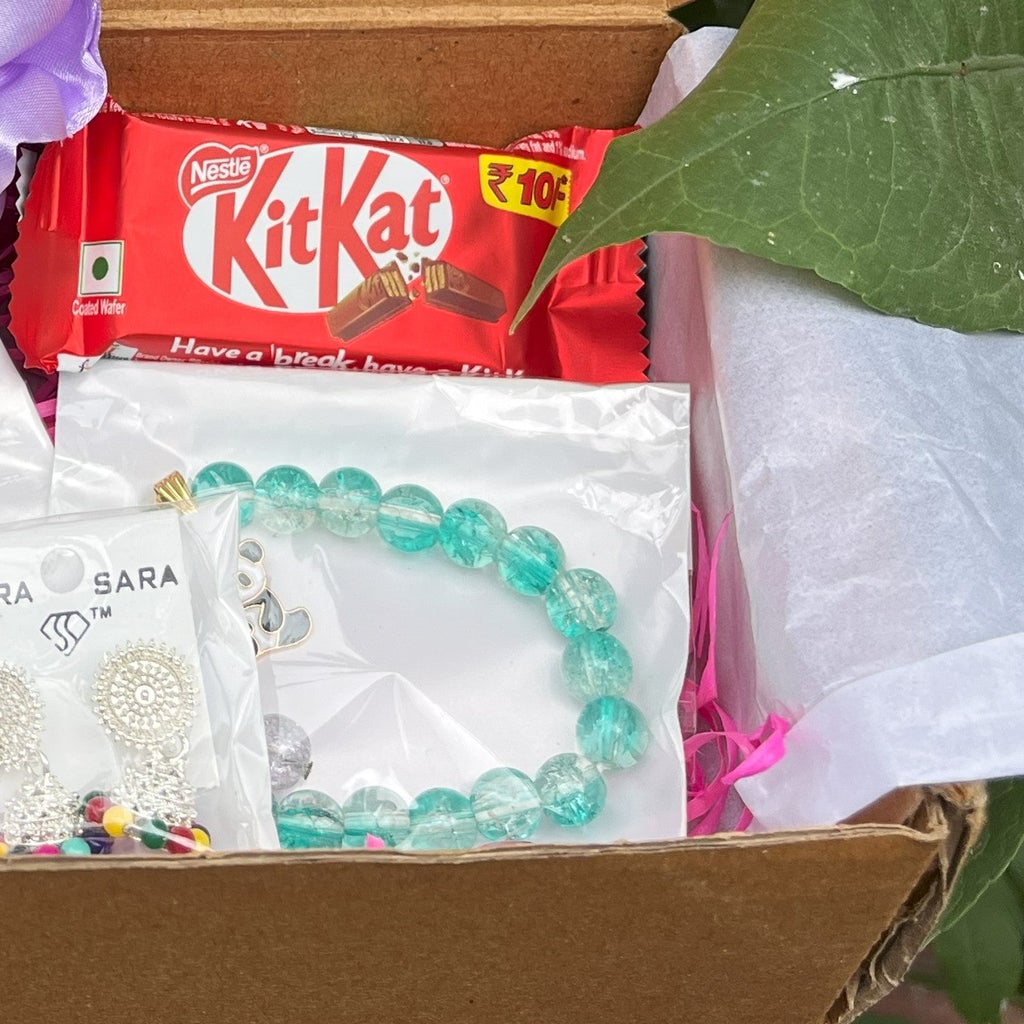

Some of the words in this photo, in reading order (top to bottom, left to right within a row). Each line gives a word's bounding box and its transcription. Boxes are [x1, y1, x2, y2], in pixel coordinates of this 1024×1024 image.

[210, 147, 442, 309] KitKat
[72, 298, 99, 316] Coated
[100, 298, 126, 315] Wafer
[170, 336, 241, 359] Have
[245, 348, 263, 361] a
[93, 564, 179, 595] SARA
[90, 605, 112, 619] TM
